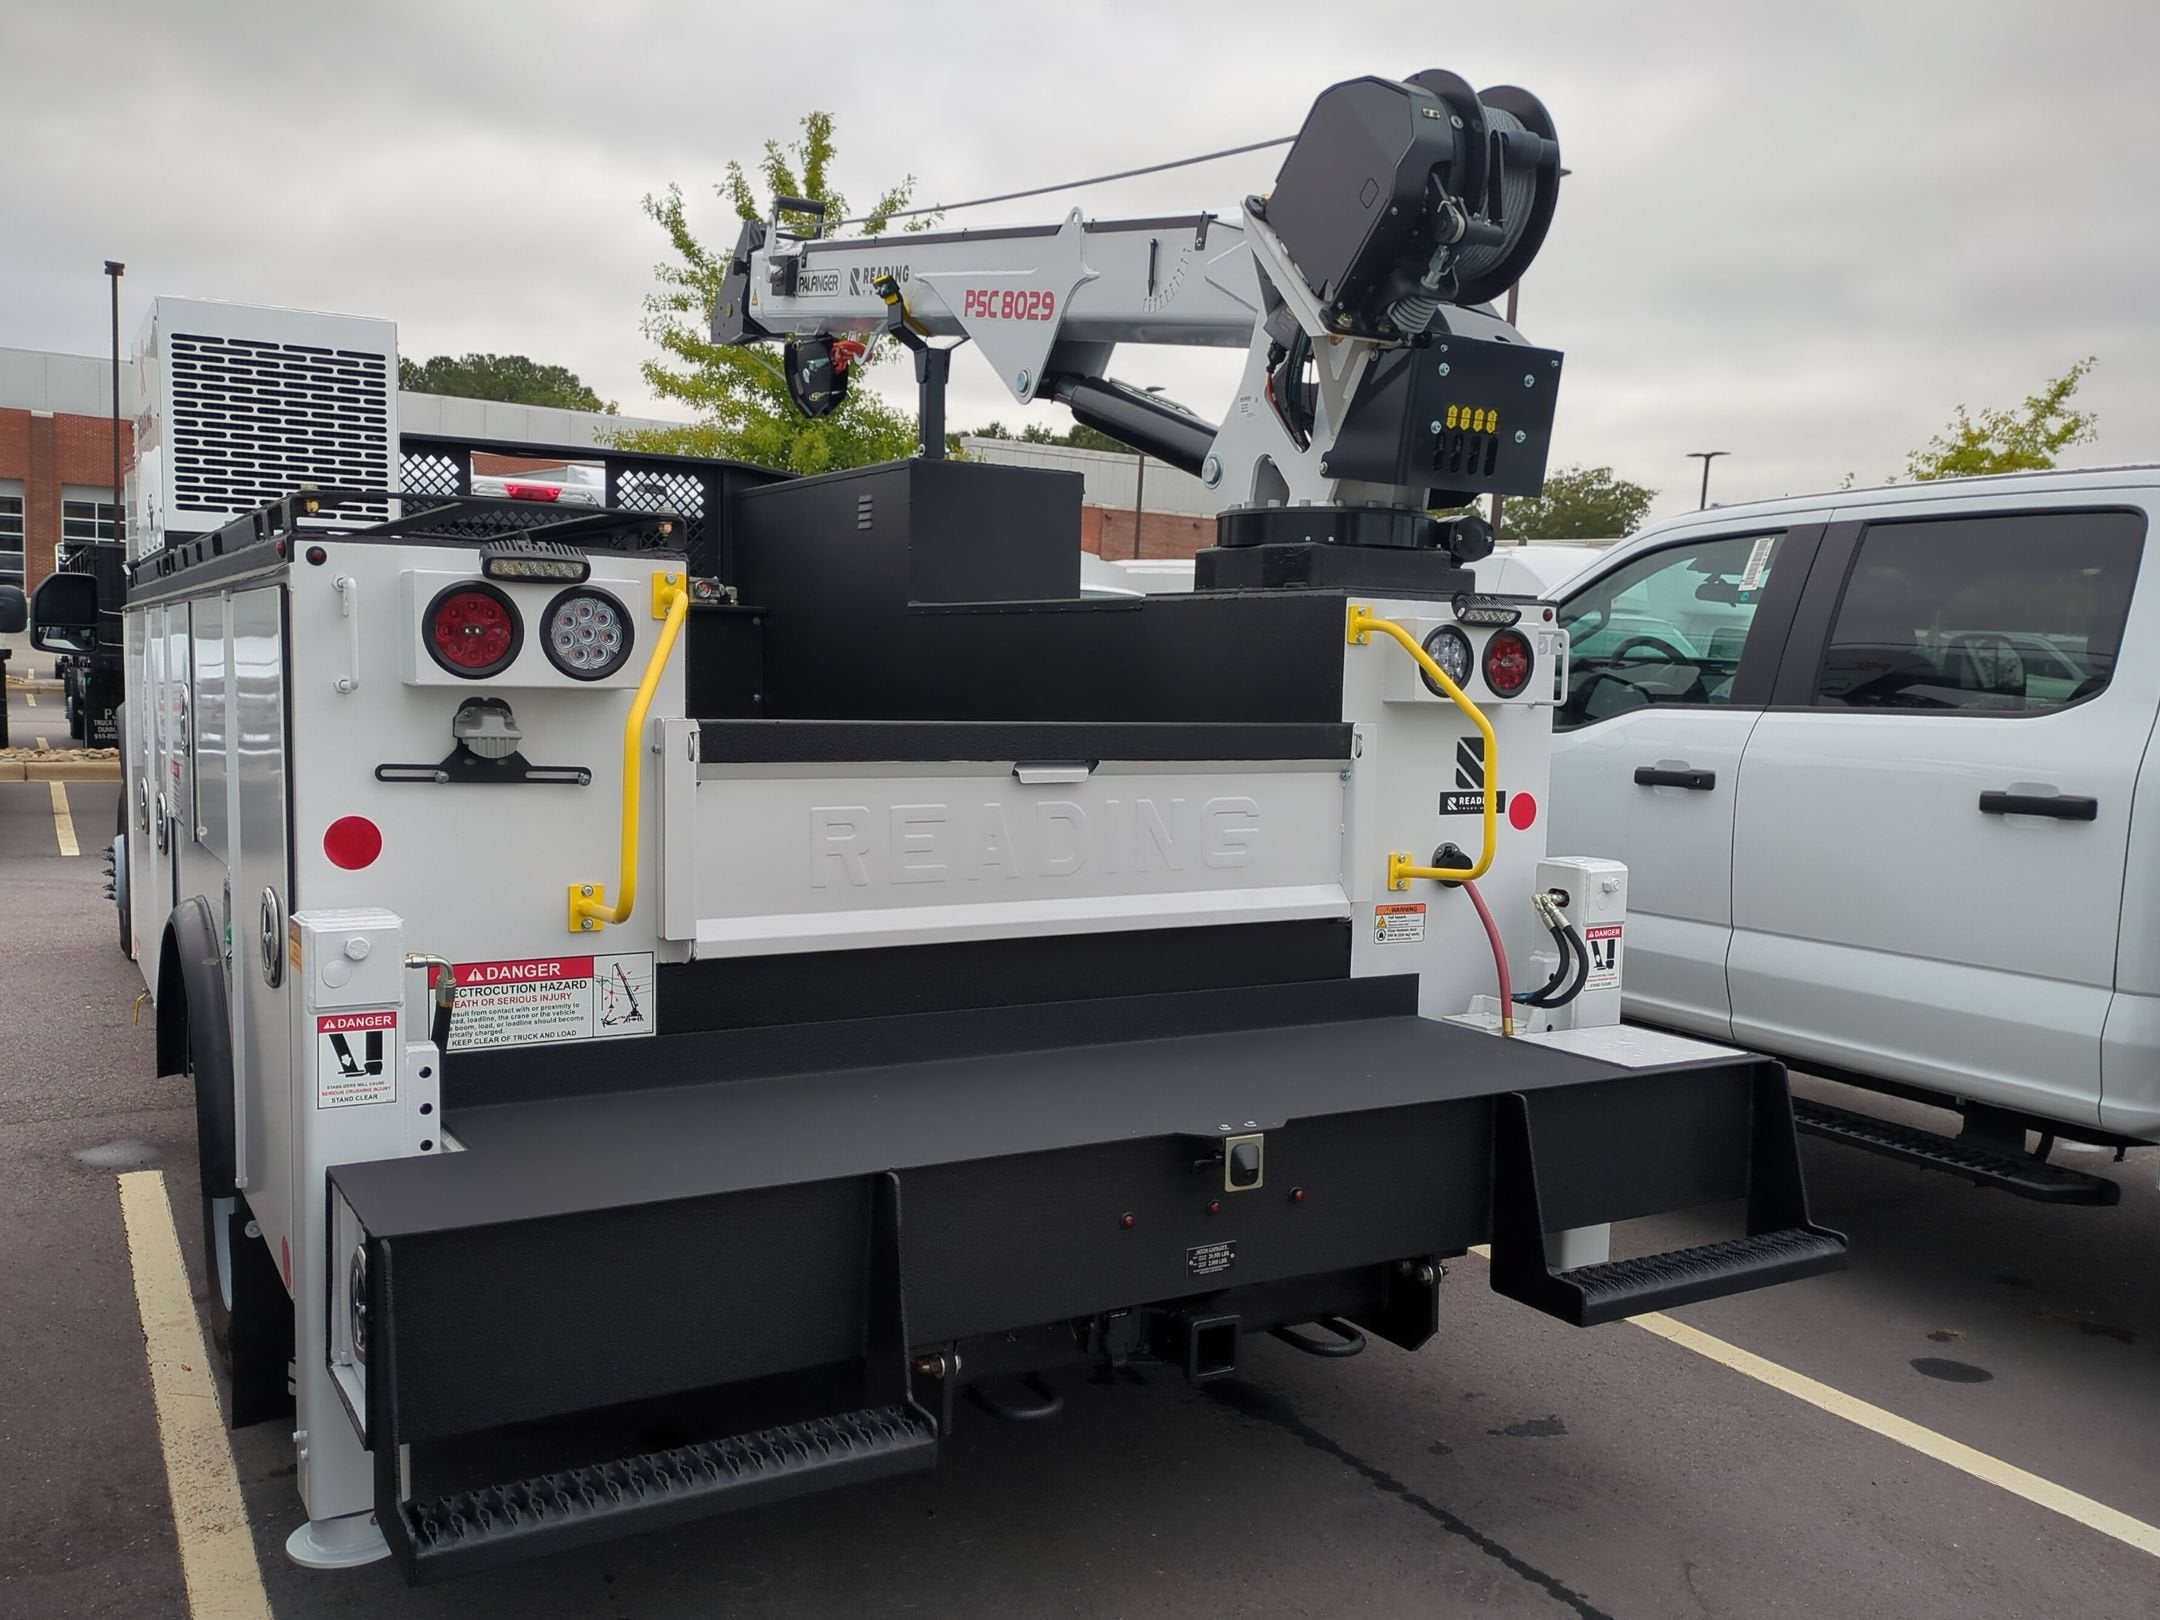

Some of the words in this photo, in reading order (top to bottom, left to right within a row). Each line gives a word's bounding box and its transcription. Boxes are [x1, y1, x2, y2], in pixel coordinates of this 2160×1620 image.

[799, 274, 839, 293] PALFINGER
[964, 289, 999, 318] PSC
[1001, 290, 1055, 321] 8029
[810, 796, 1260, 888] READING
[1391, 905, 1418, 913] WARNING
[1594, 928, 1620, 937] DANGER
[486, 962, 561, 981] DANGER
[455, 983, 536, 998] ECTROCUTION
[540, 979, 587, 992] HAZARD
[454, 999, 478, 1009] EATH
[481, 998, 495, 1007] OR
[497, 995, 538, 1005] SERIOUS
[540, 992, 572, 1002] INJURY
[488, 1007, 514, 1015] contact
[540, 1003, 571, 1011] proximity
[337, 1016, 392, 1029] DANGER
[506, 1019, 532, 1027] loadline
[534, 1017, 557, 1025] should
[452, 1039, 472, 1047] KEEP
[474, 1036, 499, 1045] CLEAR
[513, 1033, 538, 1041] TRUCK
[557, 1030, 577, 1038] LOAD
